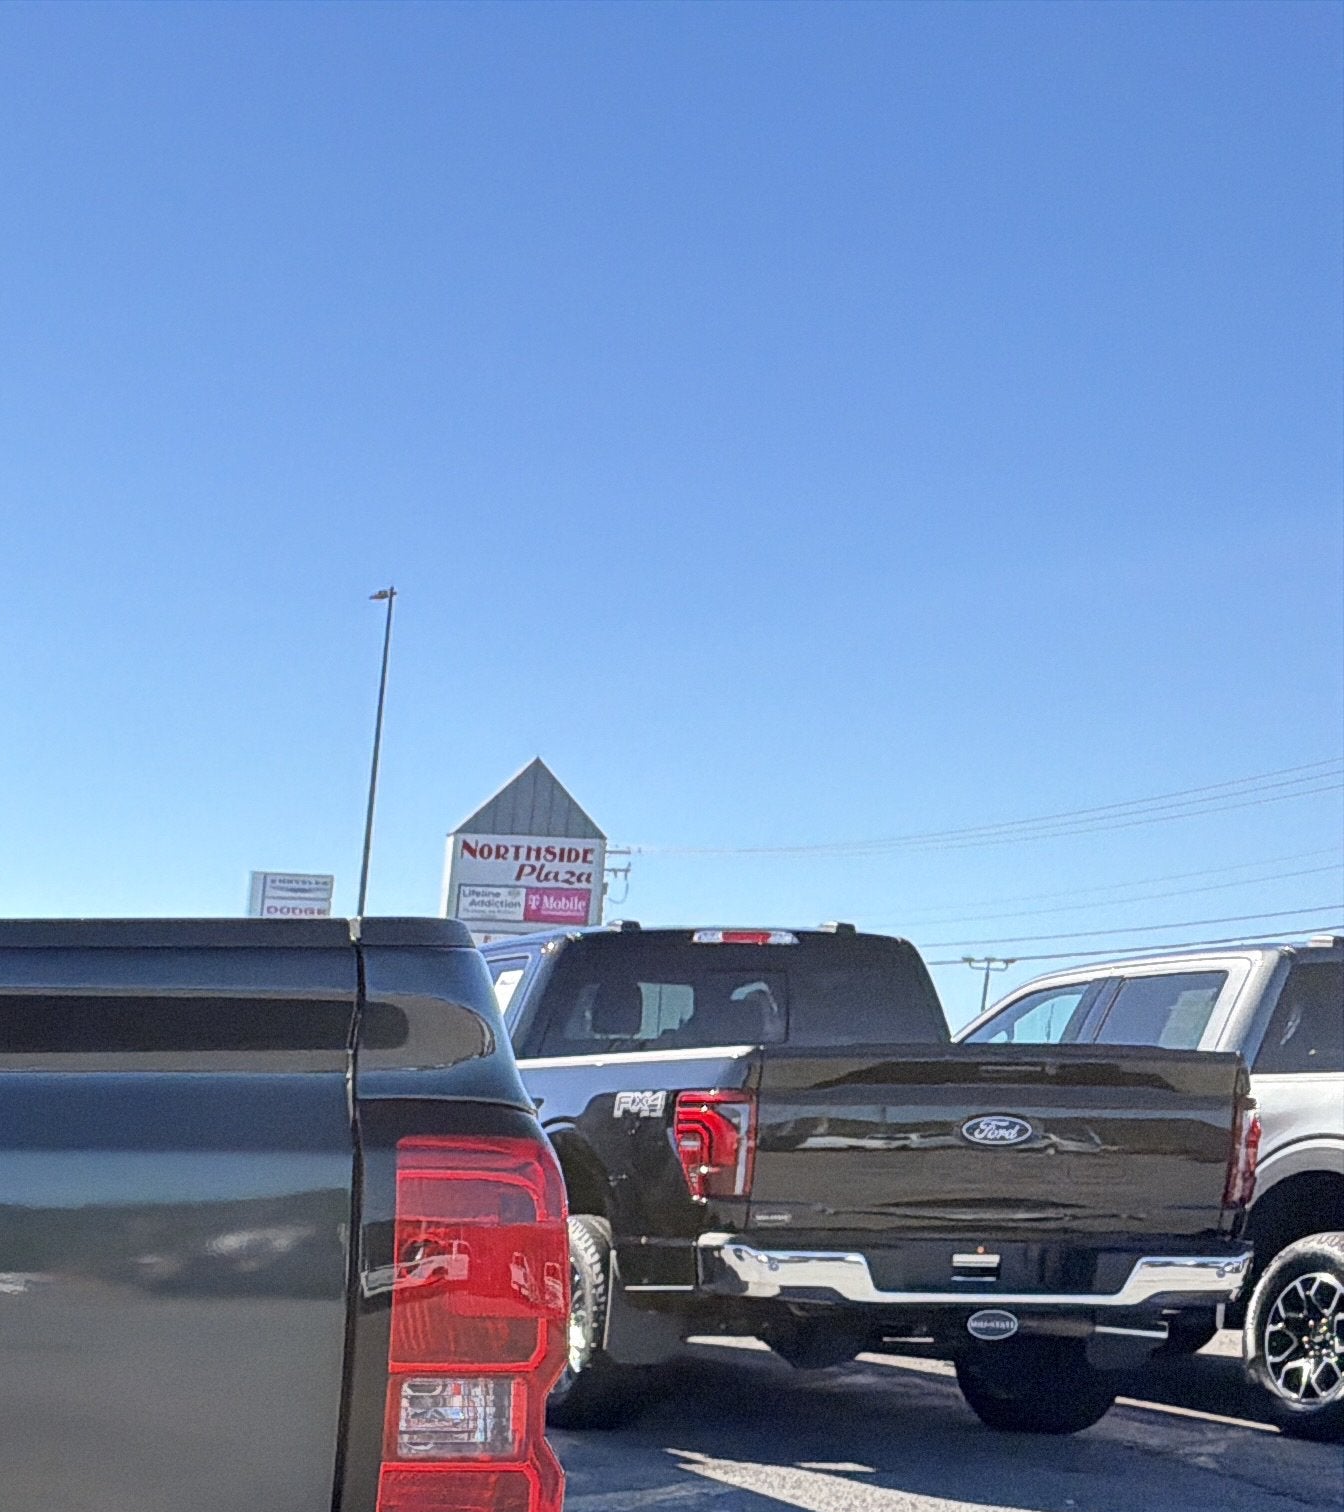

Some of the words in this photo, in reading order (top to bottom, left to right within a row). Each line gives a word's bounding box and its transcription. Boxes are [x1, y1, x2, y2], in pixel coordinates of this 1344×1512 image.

[461, 838, 595, 865] NORTHSIDE
[515, 863, 593, 886] Plaza
[469, 899, 522, 909] Addiction
[542, 895, 587, 911] Mobile
[613, 1090, 667, 1118] FX4
[973, 1119, 1021, 1139] Ford
